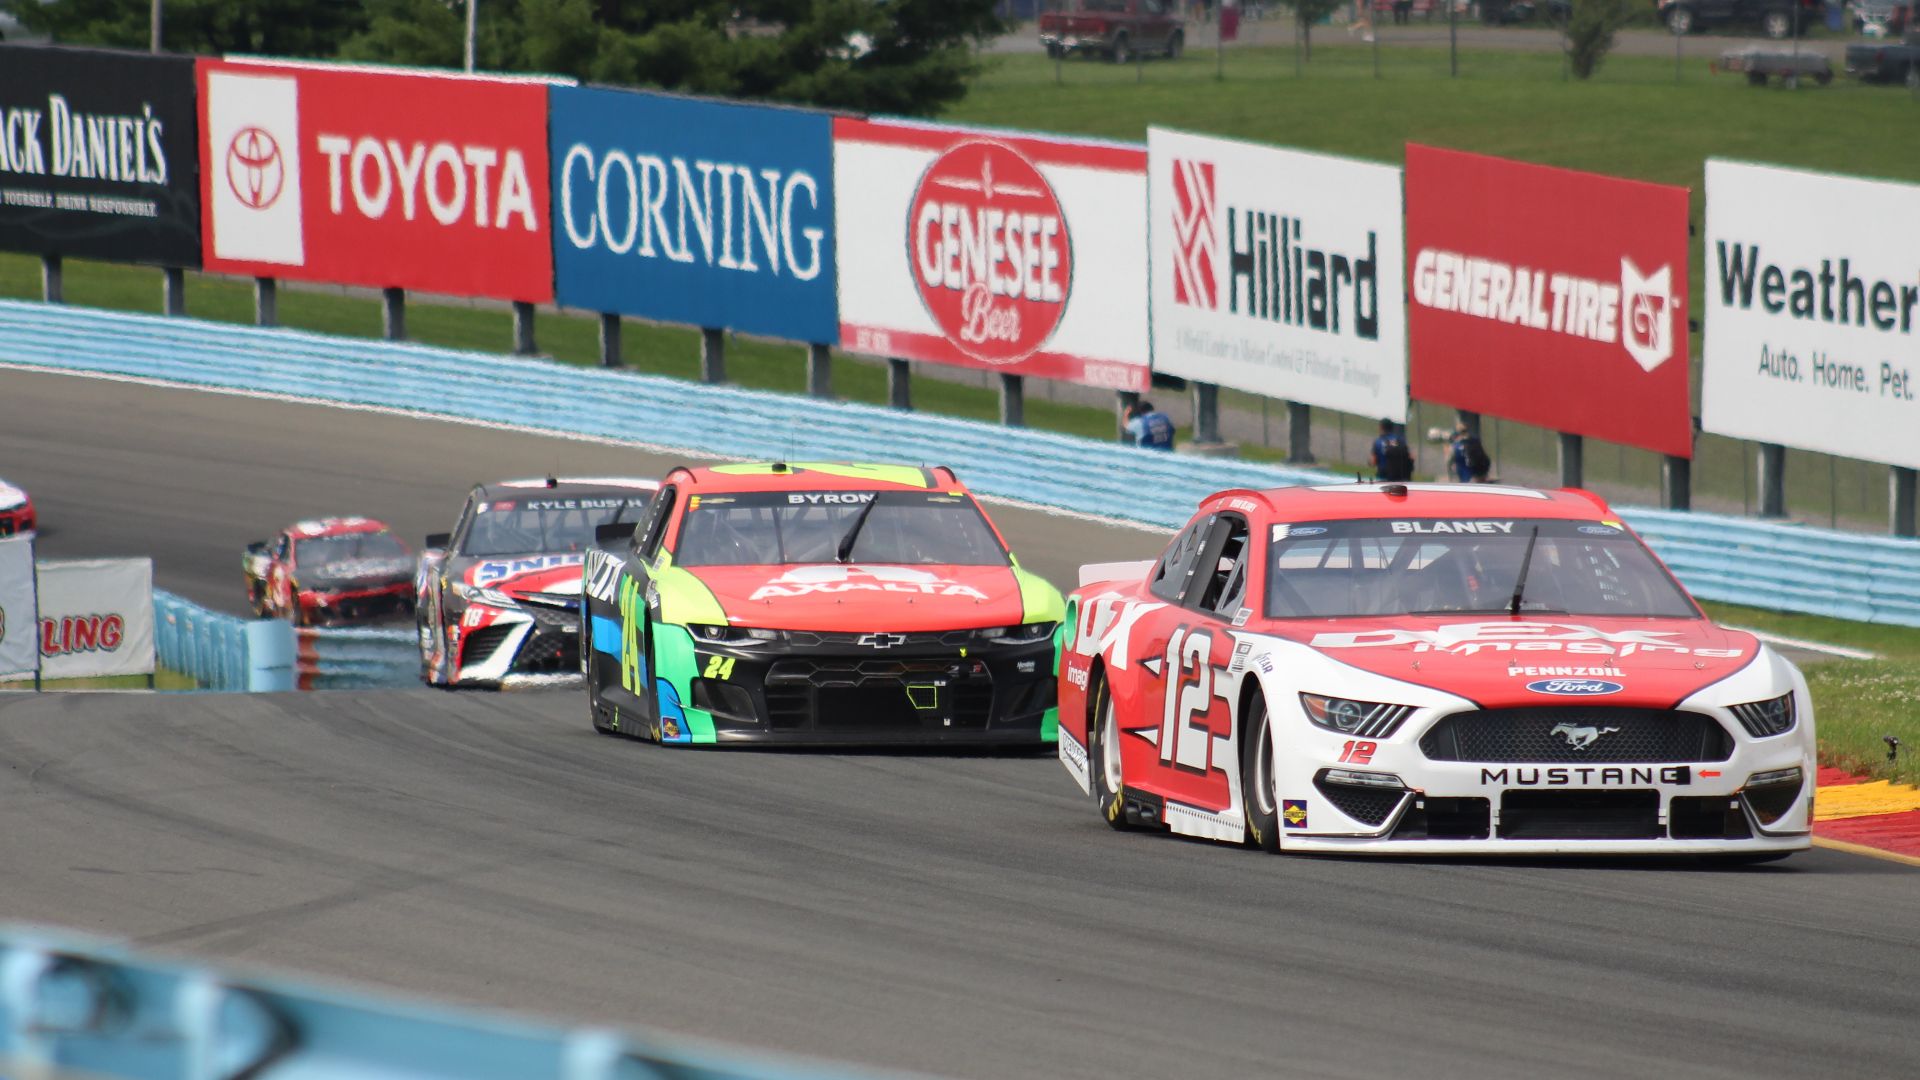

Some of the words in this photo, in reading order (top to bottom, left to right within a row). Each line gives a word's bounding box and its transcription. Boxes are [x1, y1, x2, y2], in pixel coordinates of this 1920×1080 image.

[318, 134, 538, 232] TOYOTA
[561, 144, 824, 281] CORNING
[917, 201, 1062, 303] GENESEE
[1227, 206, 1379, 341] Hilliard
[1414, 247, 1550, 330] GENERAL
[1550, 273, 1619, 343] TIRE
[961, 283, 1021, 343] Beer
[1759, 343, 1802, 382] Auto.
[1813, 351, 1869, 393] Home.
[1880, 361, 1913, 401] Pet.
[527, 501, 577, 511] KYLE
[581, 499, 643, 509] BUSCH
[788, 493, 878, 504] BYRON
[1390, 521, 1515, 534] BLANEY
[749, 581, 989, 600] AXALTA
[463, 607, 485, 627] 18
[704, 655, 735, 680] 24
[1508, 666, 1626, 677] PENNZOIL
[1537, 679, 1613, 694] Ford
[1160, 624, 1211, 776] 12
[1337, 740, 1378, 765] 12
[1480, 767, 1680, 785] MUSTANG
